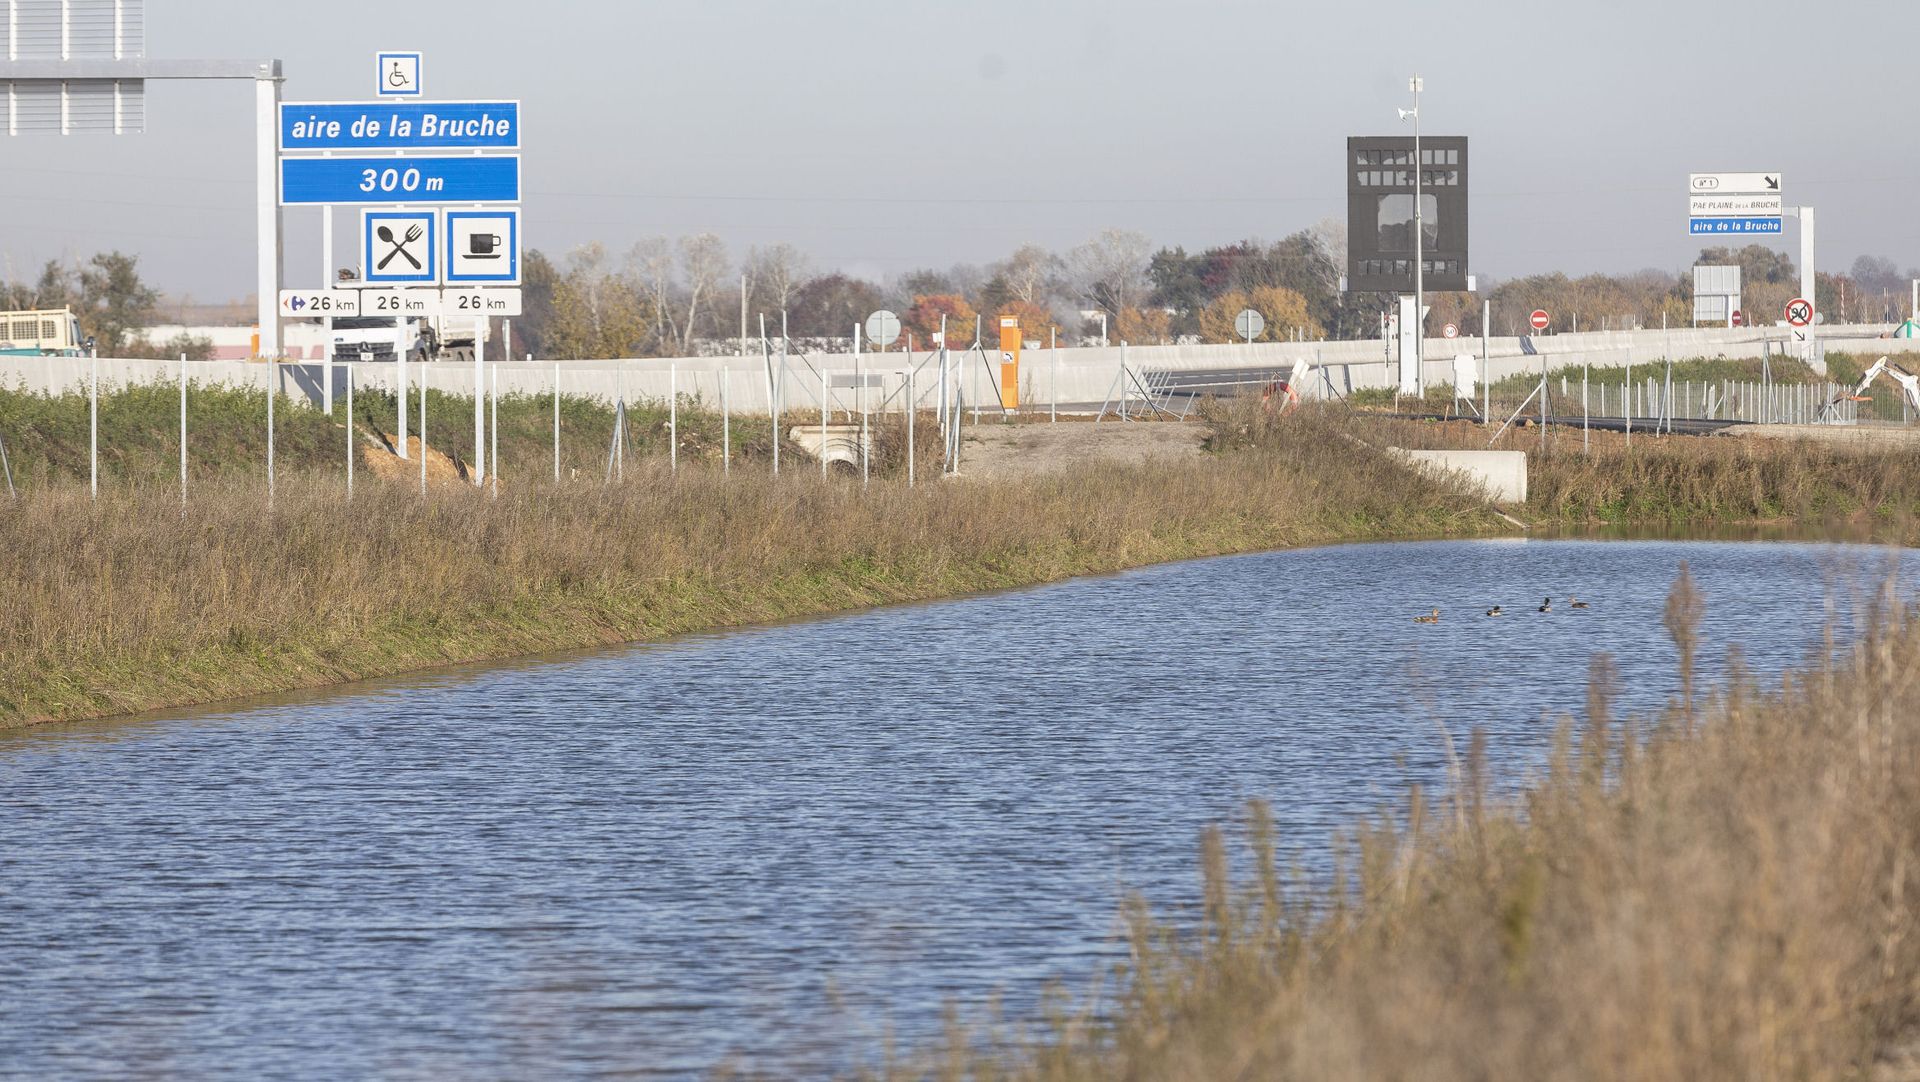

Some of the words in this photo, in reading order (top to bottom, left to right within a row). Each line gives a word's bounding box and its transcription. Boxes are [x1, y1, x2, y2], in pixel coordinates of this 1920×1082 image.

[292, 115, 341, 138] aire
[351, 114, 380, 138] de
[389, 114, 412, 137] la
[420, 113, 510, 137] Bruche
[359, 168, 421, 192] 300
[425, 177, 444, 191] m
[1750, 201, 1779, 209] BRUCHE
[1693, 221, 1713, 231] aire
[1716, 221, 1729, 231] de
[1732, 221, 1741, 231] la
[1745, 221, 1779, 231] Bruche
[310, 296, 331, 310] 26
[336, 297, 355, 310] km
[377, 296, 399, 310] 26
[405, 297, 424, 310] km
[458, 295, 481, 310] 26
[487, 297, 506, 309] km
[1791, 308, 1807, 318] 90
